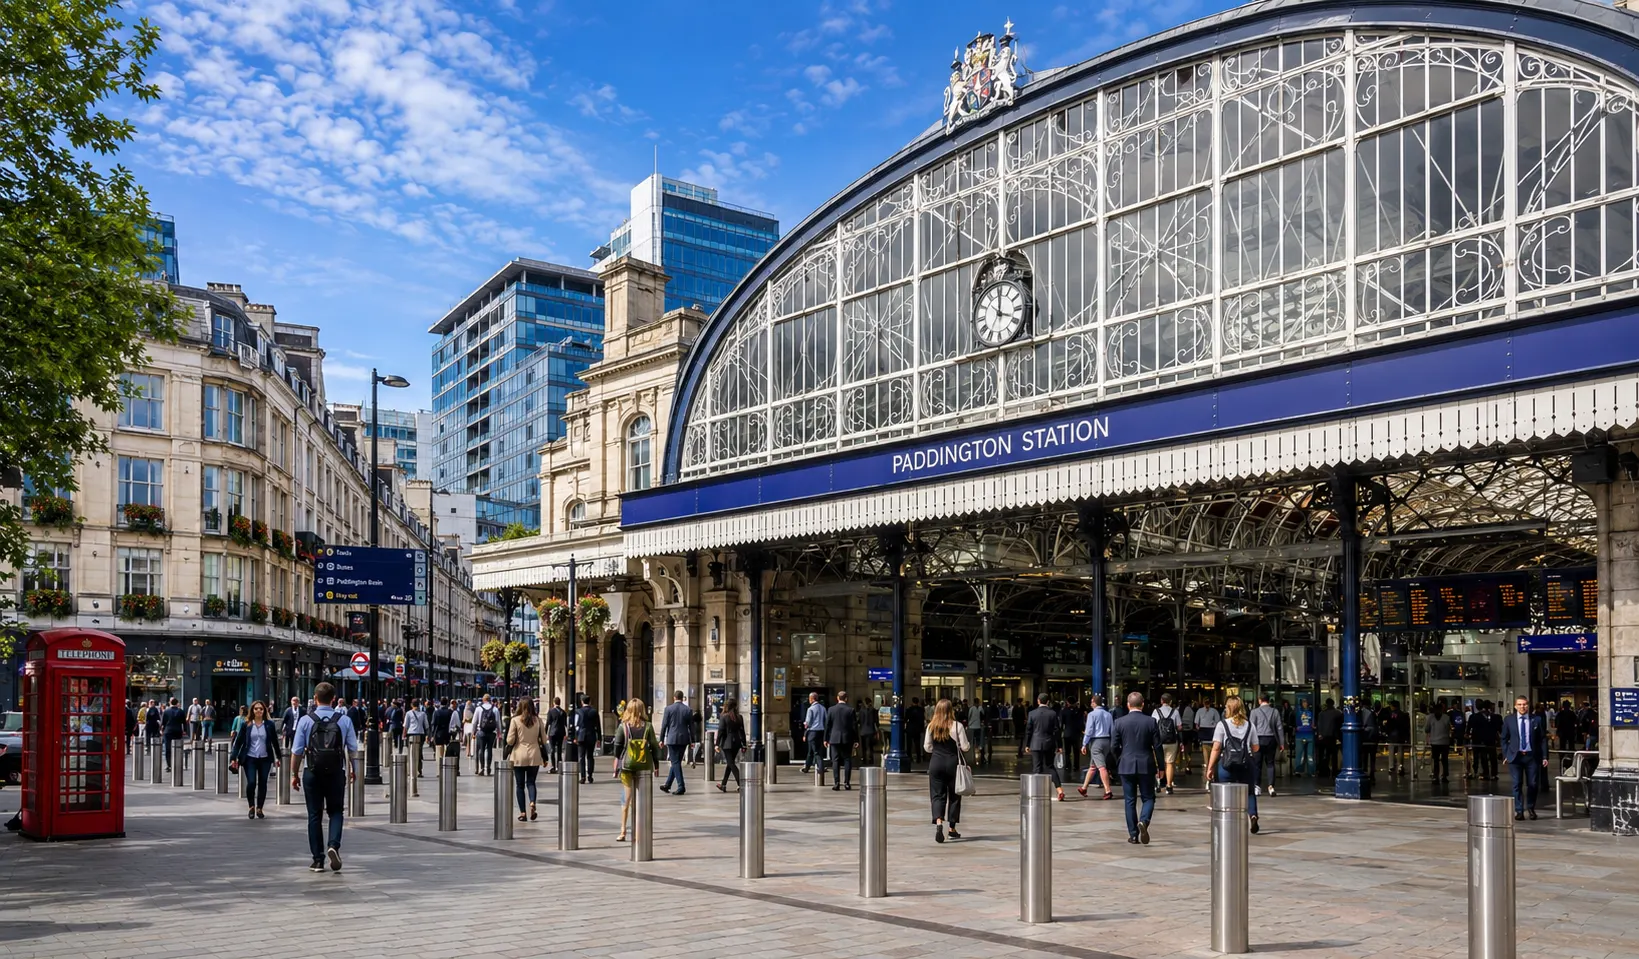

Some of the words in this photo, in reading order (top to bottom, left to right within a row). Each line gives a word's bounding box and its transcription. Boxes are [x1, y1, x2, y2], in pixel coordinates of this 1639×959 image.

[892, 434, 1012, 474] PADDINGTON
[1021, 416, 1109, 452] STATION
[61, 650, 113, 659] TELEPHONE
